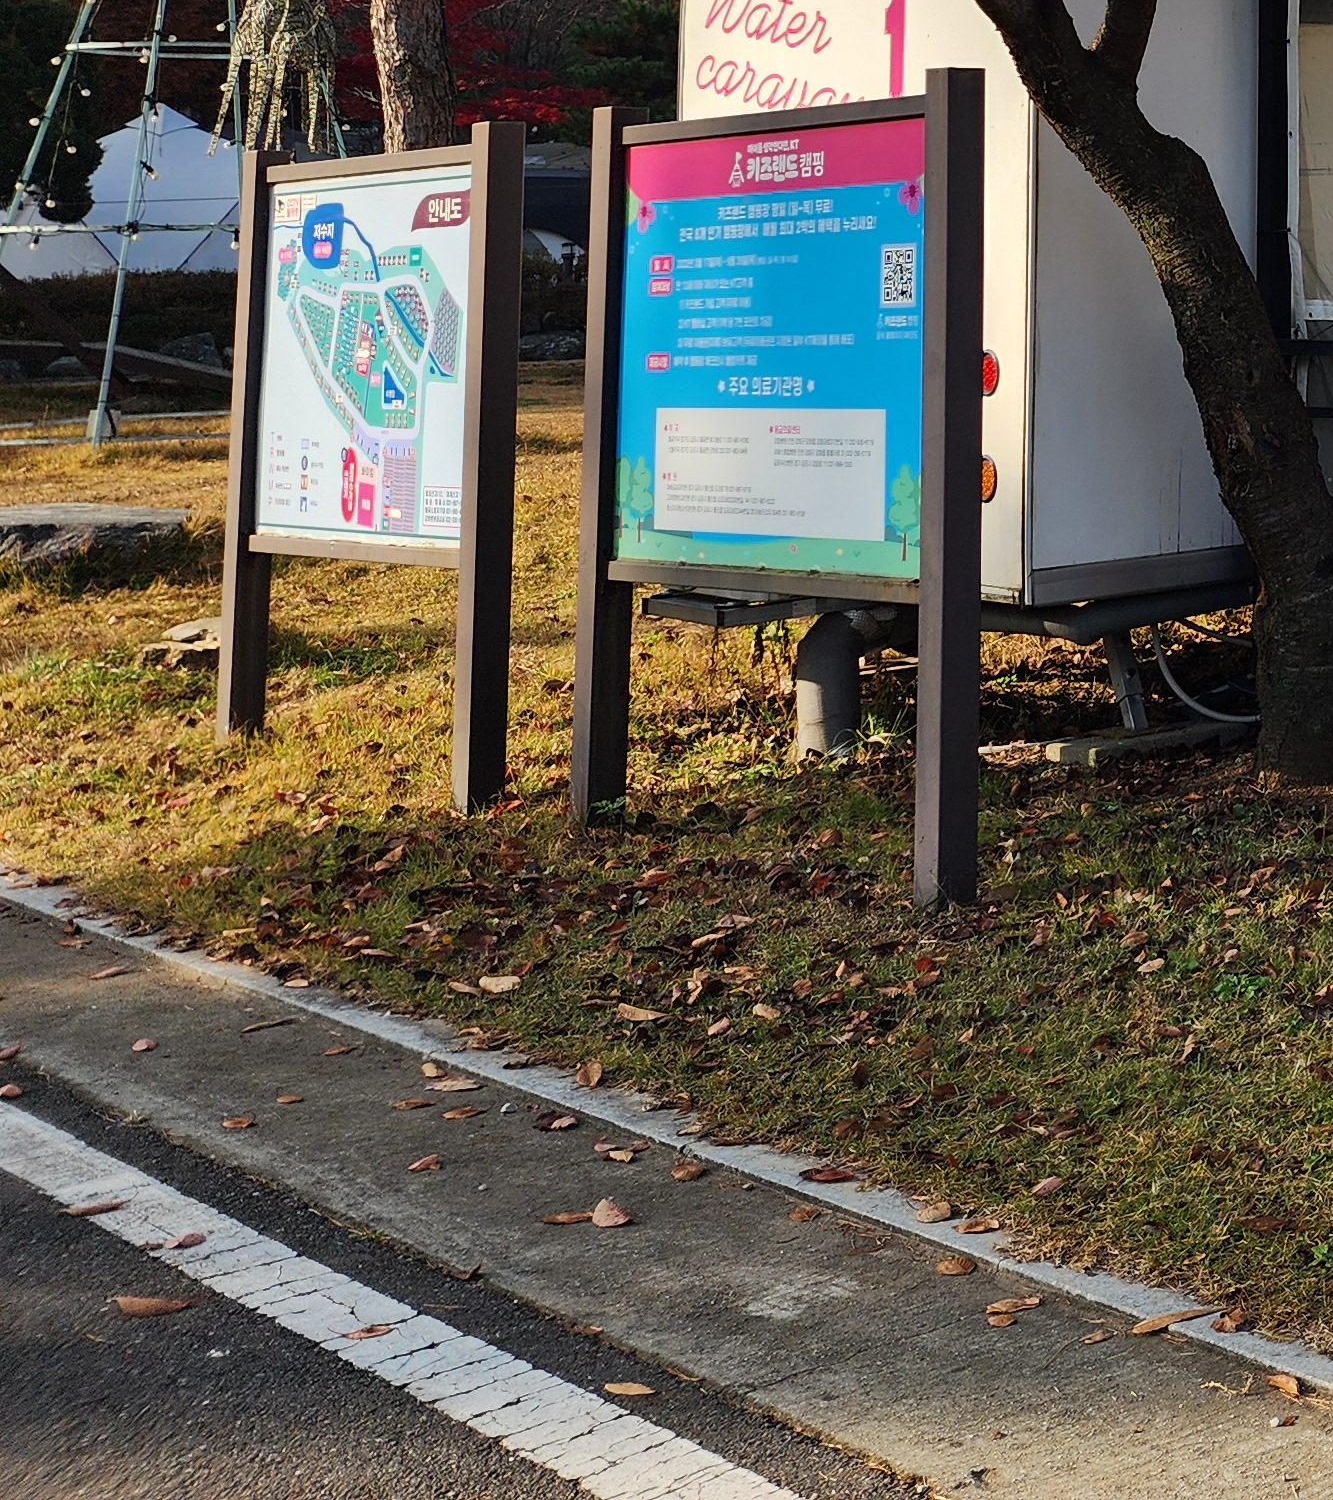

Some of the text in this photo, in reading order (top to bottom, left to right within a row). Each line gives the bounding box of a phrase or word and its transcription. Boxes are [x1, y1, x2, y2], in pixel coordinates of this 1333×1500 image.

[695, 54, 866, 110] carava
[746, 151, 824, 182] 키즈랜드 캠핑
[428, 197, 462, 223] 안내도
[313, 221, 335, 241] 저수지
[728, 376, 803, 397] 주요 의료기관명
